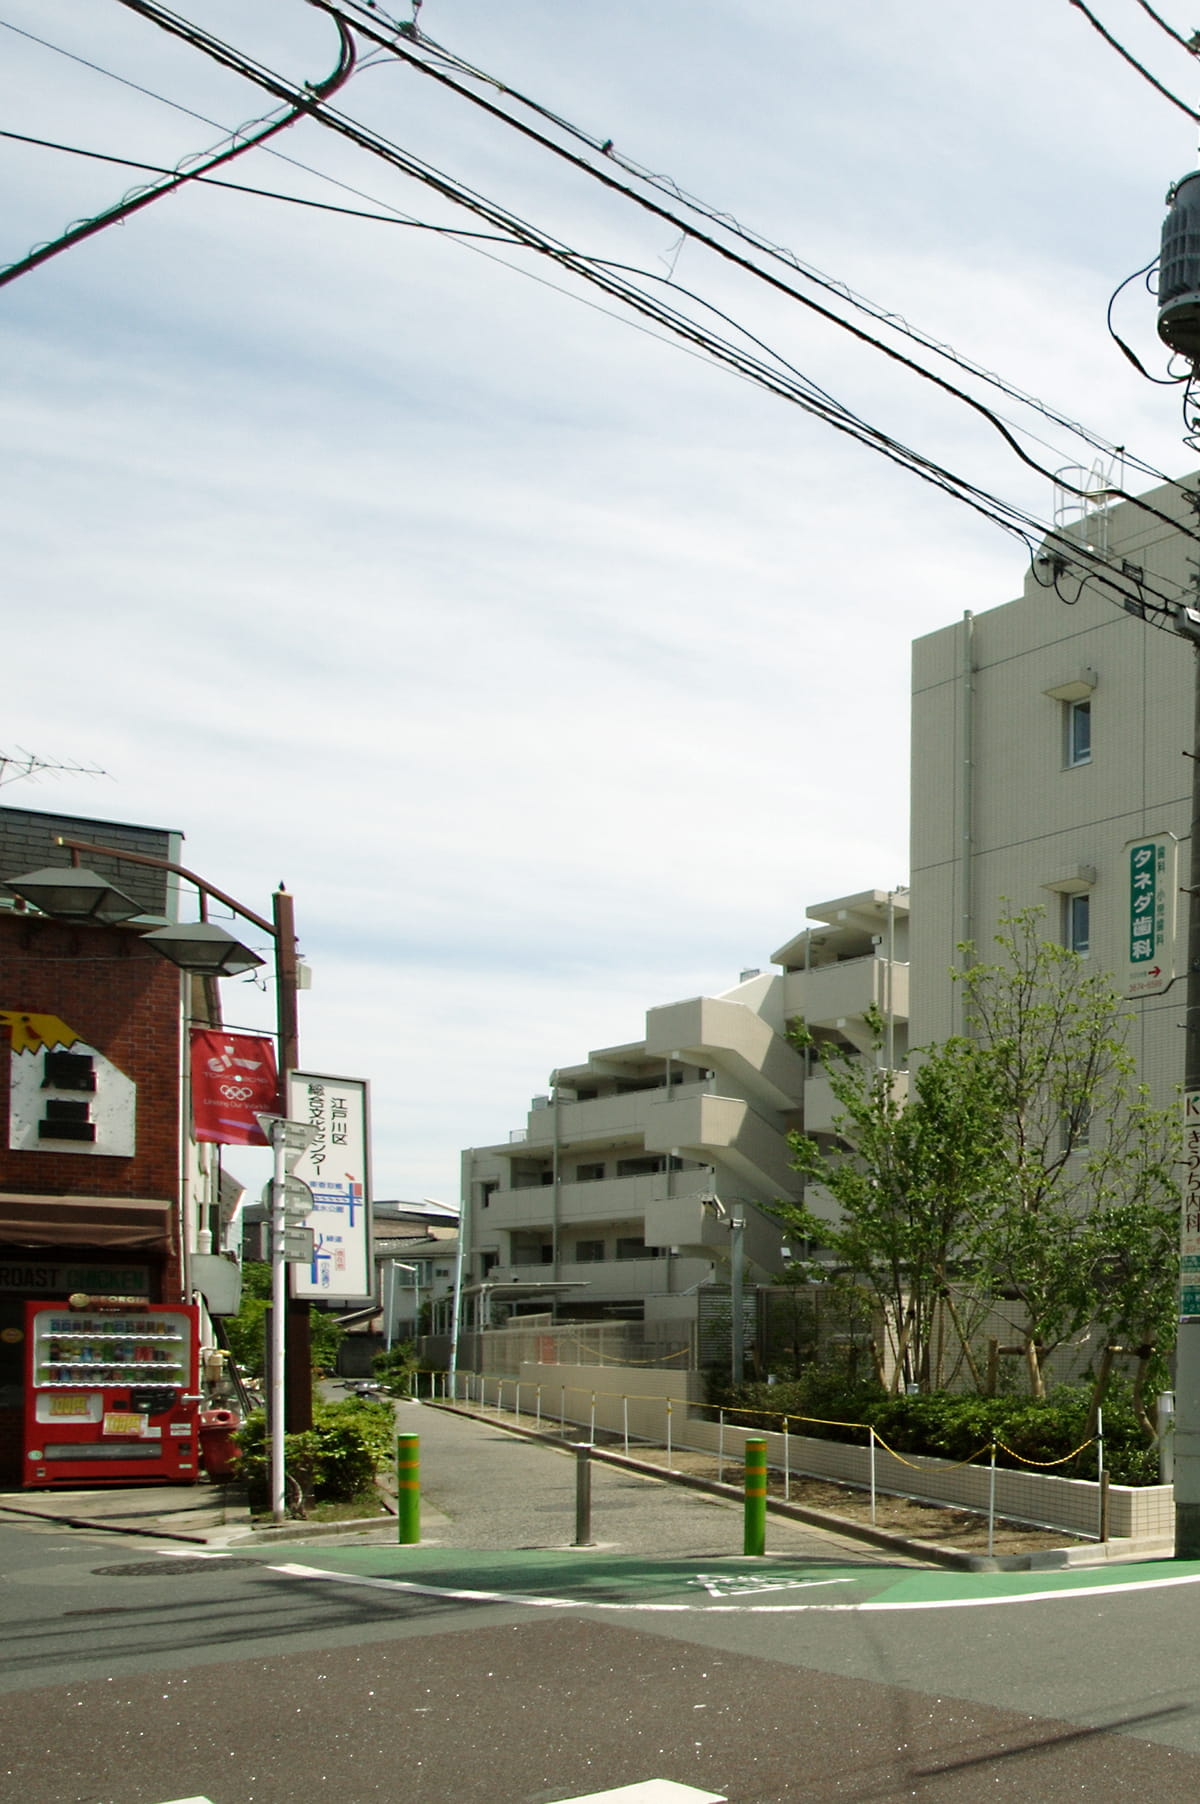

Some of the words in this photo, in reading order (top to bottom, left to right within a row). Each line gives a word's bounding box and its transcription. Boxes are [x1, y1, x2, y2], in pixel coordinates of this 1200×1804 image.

[1132, 849, 1153, 959] タネダ歯科
[331, 1097, 348, 1145] 江戸川区
[0, 1267, 60, 1288] ROAST
